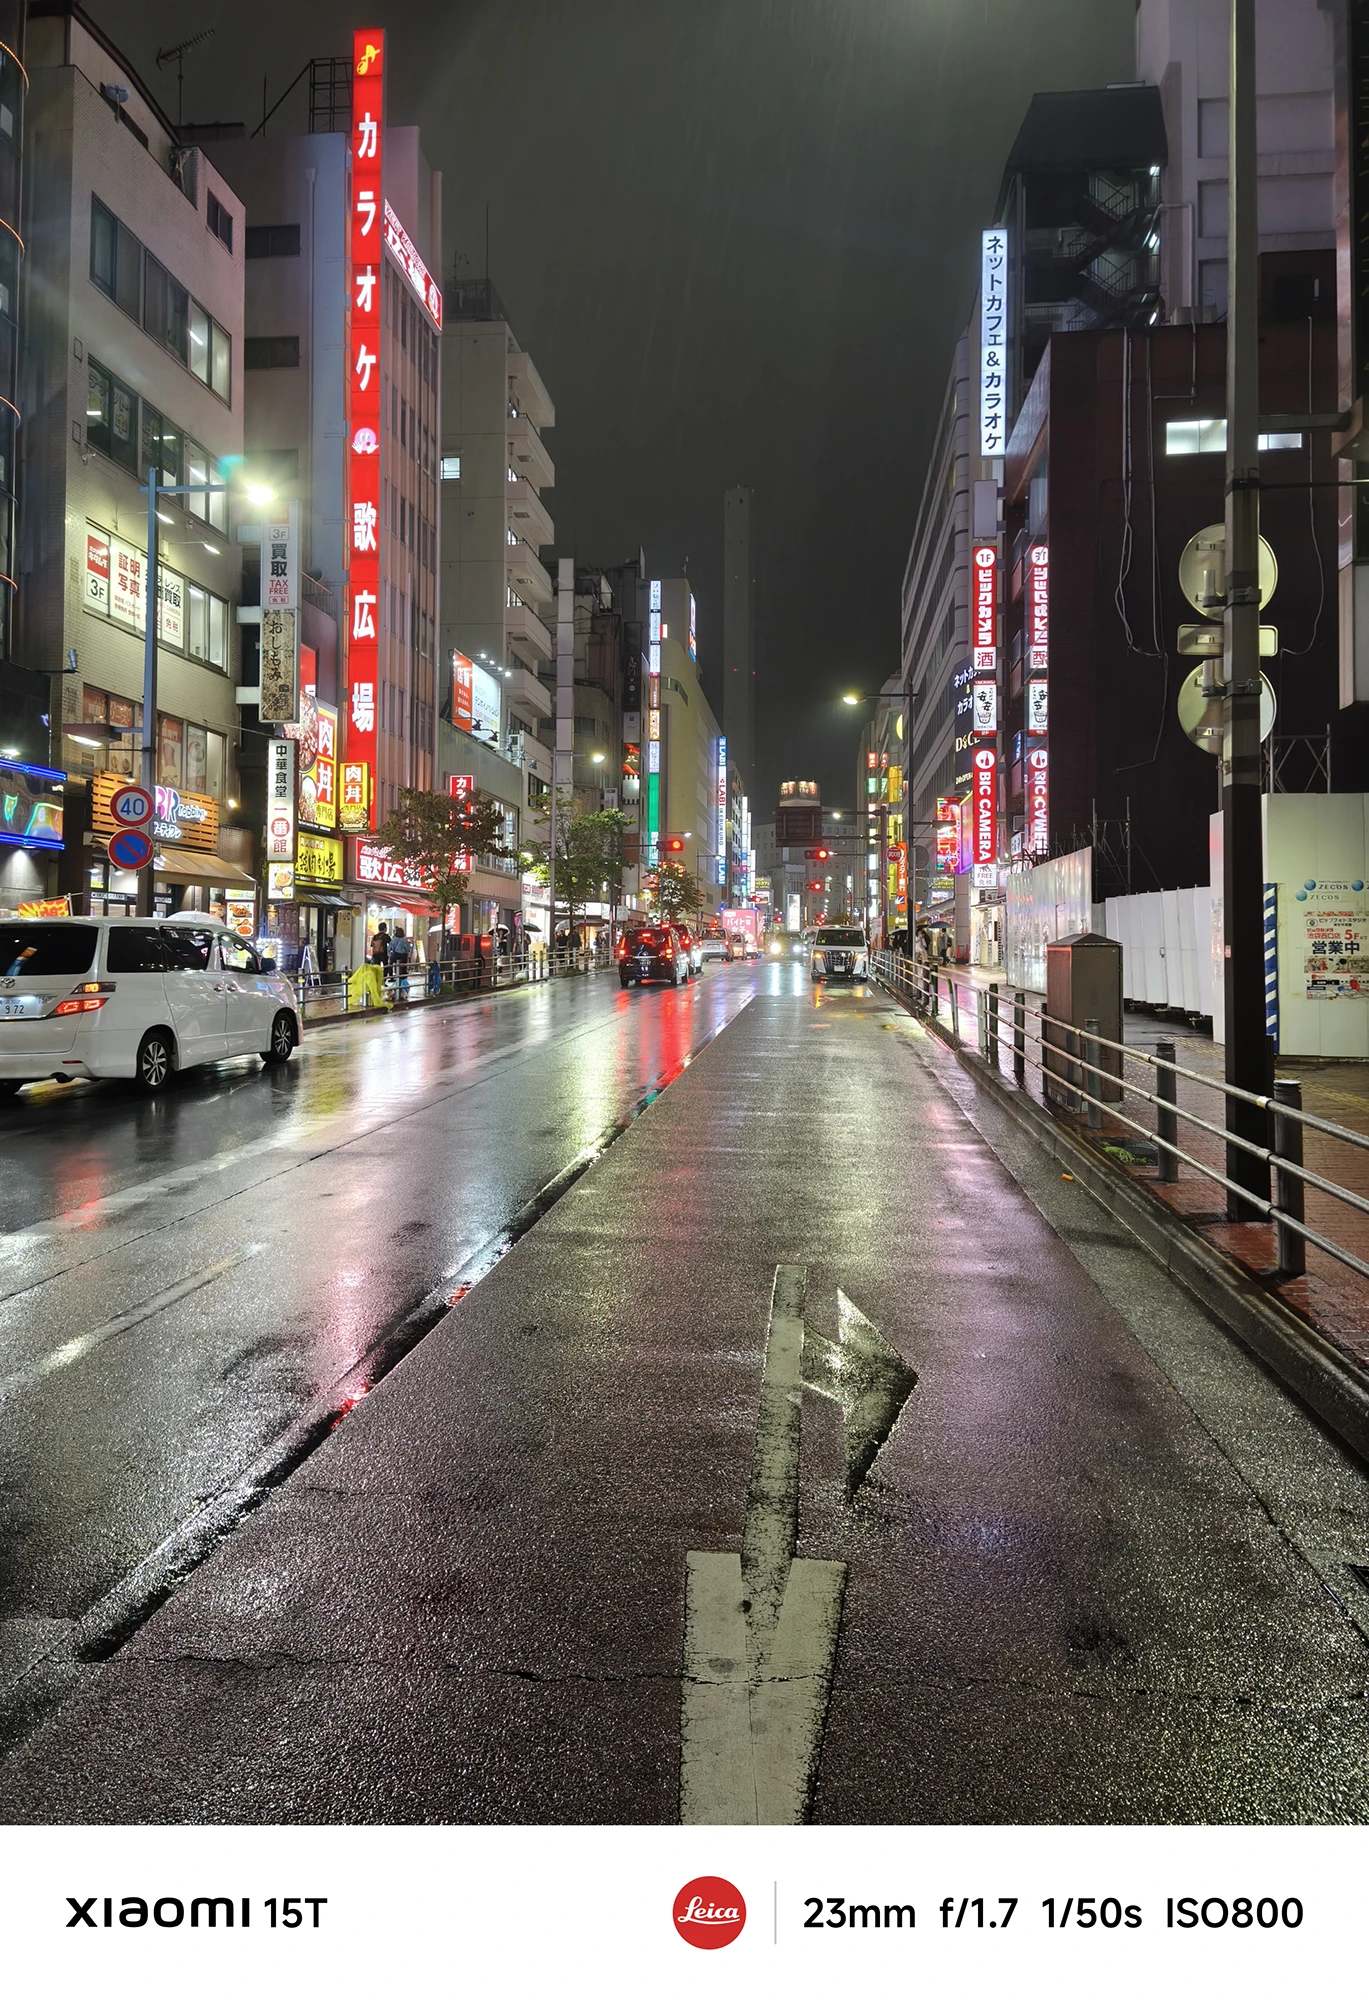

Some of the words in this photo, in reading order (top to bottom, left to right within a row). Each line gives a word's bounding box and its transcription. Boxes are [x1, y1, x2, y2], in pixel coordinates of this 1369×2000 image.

[355, 112, 379, 391] カラオケ
[984, 236, 1004, 450] ネットカフェ&カラオケ
[272, 529, 286, 539] 3F
[118, 551, 140, 578] 証明
[271, 543, 287, 577] 買取
[980, 553, 992, 563] 1F
[90, 578, 105, 599] 3F
[118, 573, 140, 598] 写真
[269, 579, 289, 587] TAX
[269, 587, 289, 595] FREE
[351, 501, 377, 732] 歌広場
[978, 569, 993, 645] ビックカメラ
[268, 619, 284, 682] おしもみ
[977, 652, 994, 667] 酒
[275, 744, 288, 798] 中華食堂
[317, 718, 334, 803] 肉丼
[345, 766, 362, 803] 肉丼
[978, 771, 992, 796] BIC
[120, 797, 145, 816] 40
[272, 807, 289, 854] 一番館
[978, 798, 992, 861] CAMERA
[718, 865, 726, 885] LABI
[1311, 940, 1360, 955] 営業中
[1344, 929, 1360, 940] 5F
